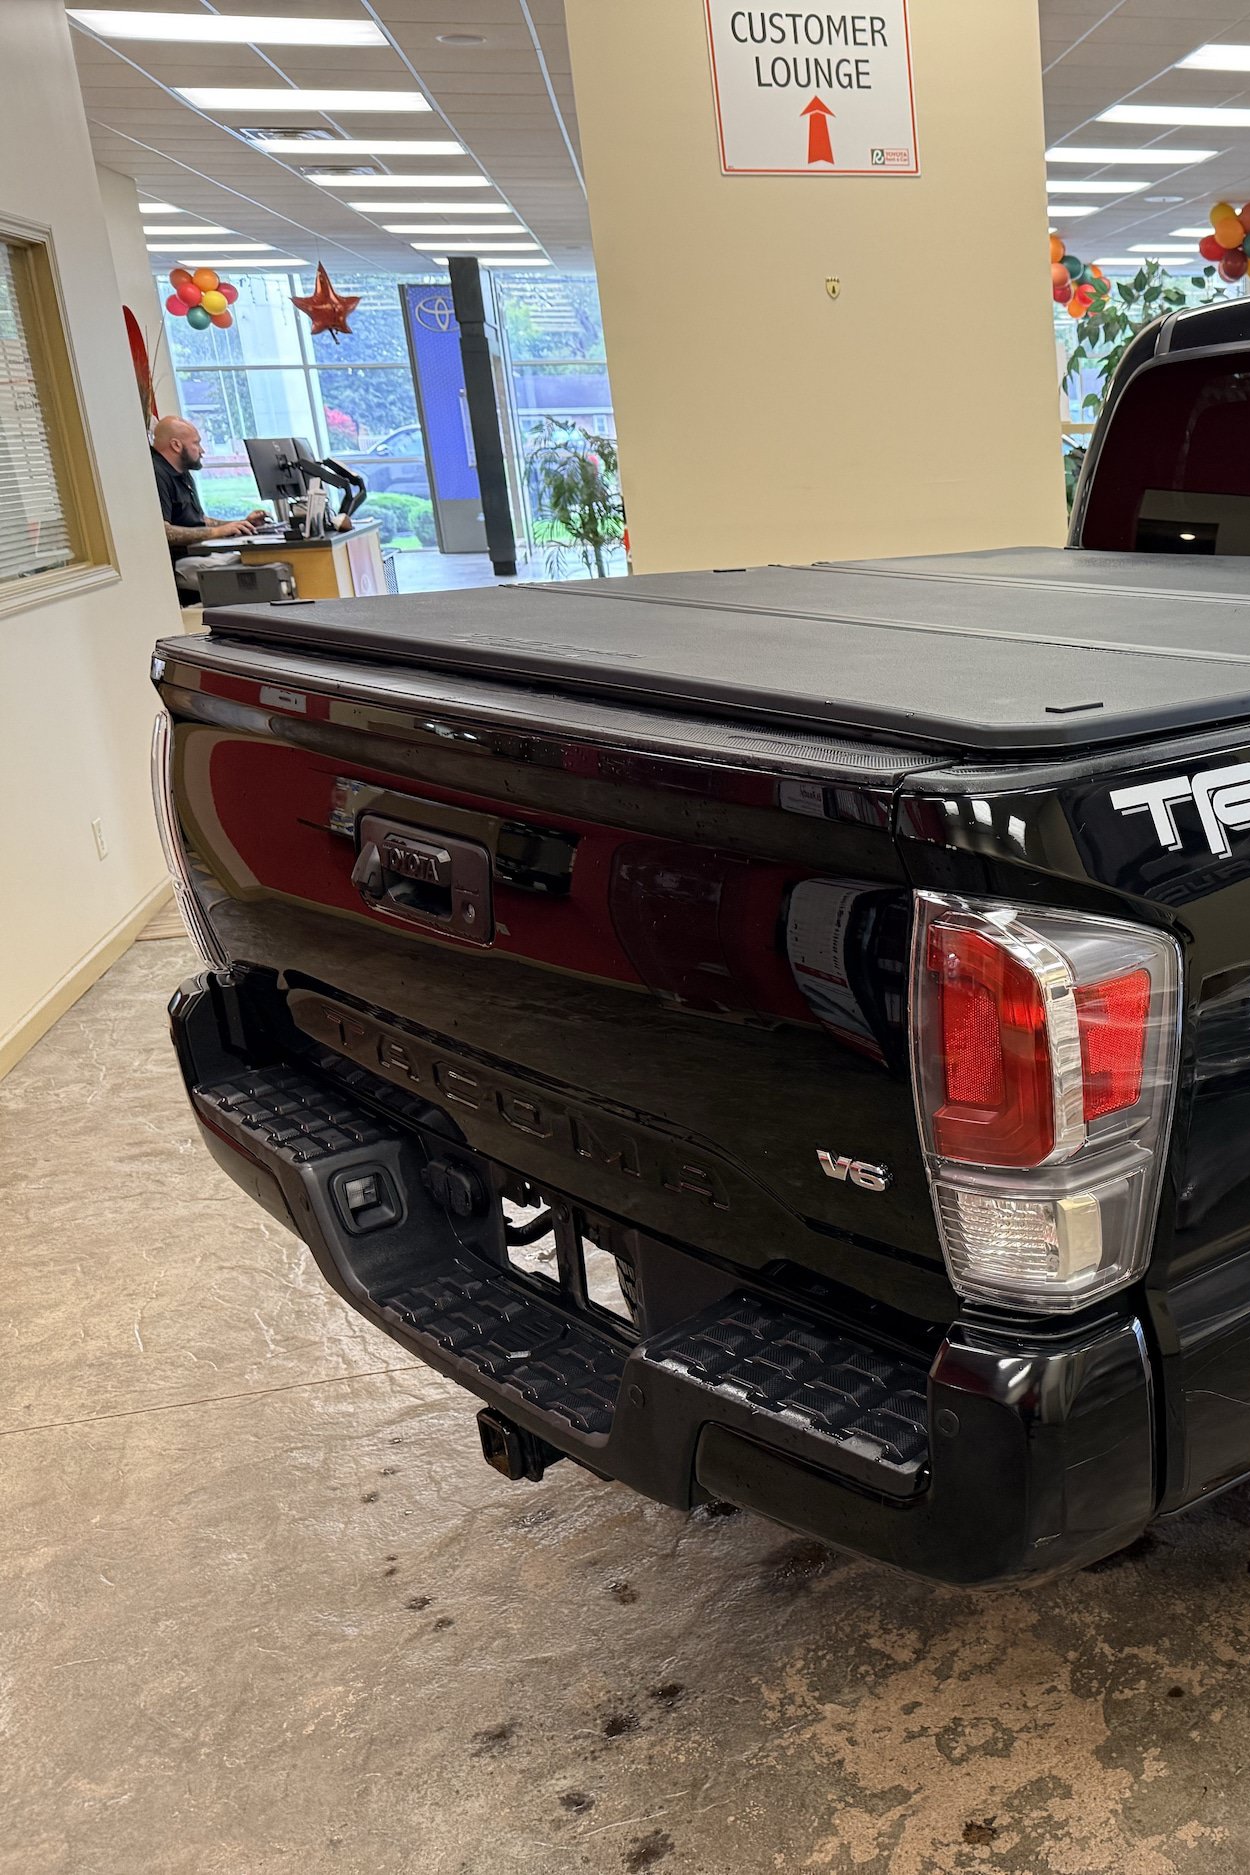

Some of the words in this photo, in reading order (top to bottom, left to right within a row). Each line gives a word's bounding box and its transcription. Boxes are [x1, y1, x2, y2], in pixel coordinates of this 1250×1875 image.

[730, 11, 888, 47] CUSTOMER
[755, 56, 872, 89] LOUNGE
[382, 842, 440, 882] TOYOTA
[320, 1003, 731, 1213] TACOMA
[816, 1149, 886, 1192] V6
